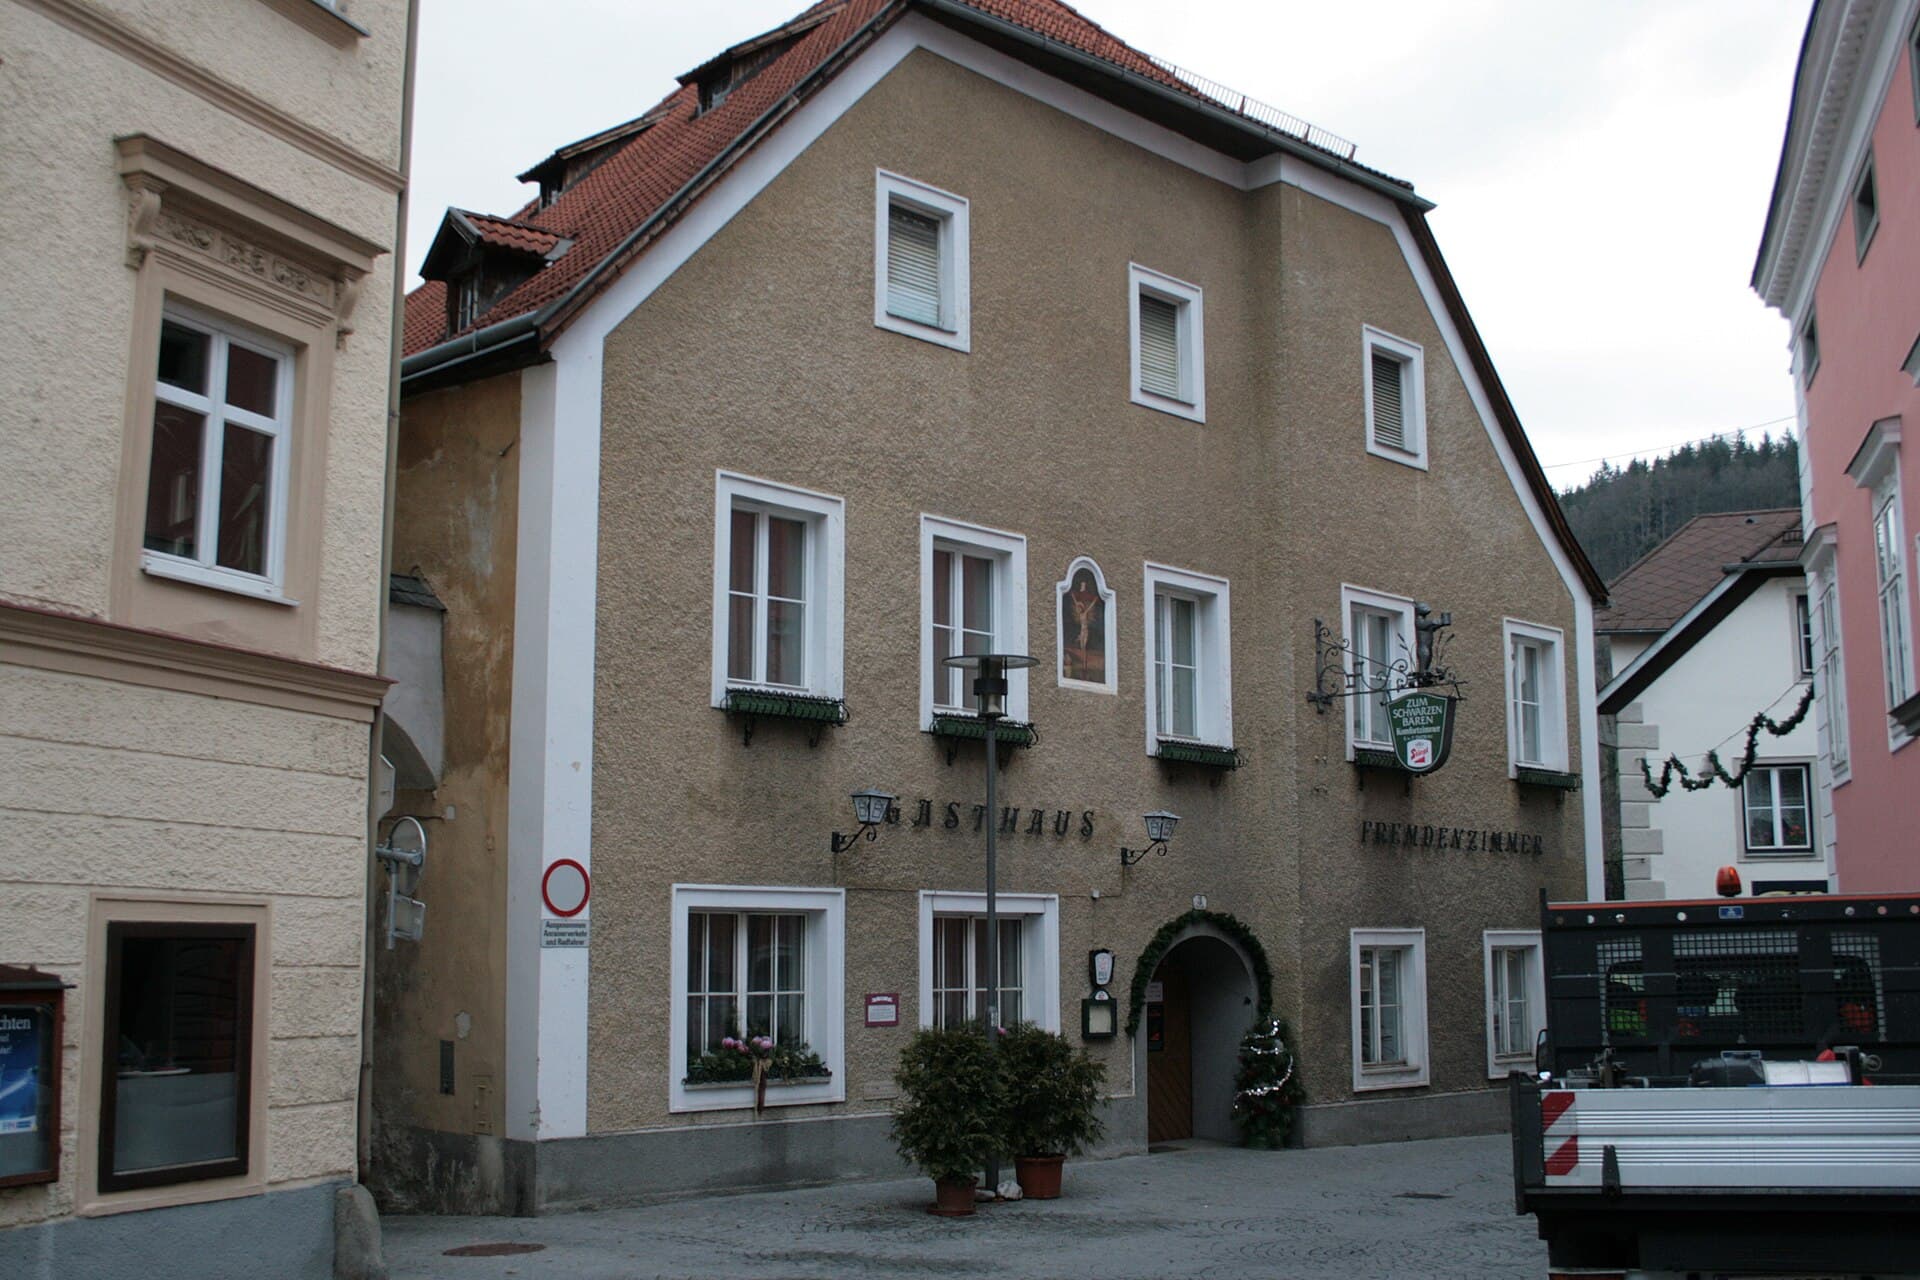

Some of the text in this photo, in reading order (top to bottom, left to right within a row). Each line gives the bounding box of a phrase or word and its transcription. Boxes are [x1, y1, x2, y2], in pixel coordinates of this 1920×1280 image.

[1392, 705, 1443, 719] SCHWARZEN
[1406, 697, 1429, 708] ZUM
[885, 799, 1095, 839] GASTHAUS
[1361, 819, 1544, 856] FREMDENZIMMER
